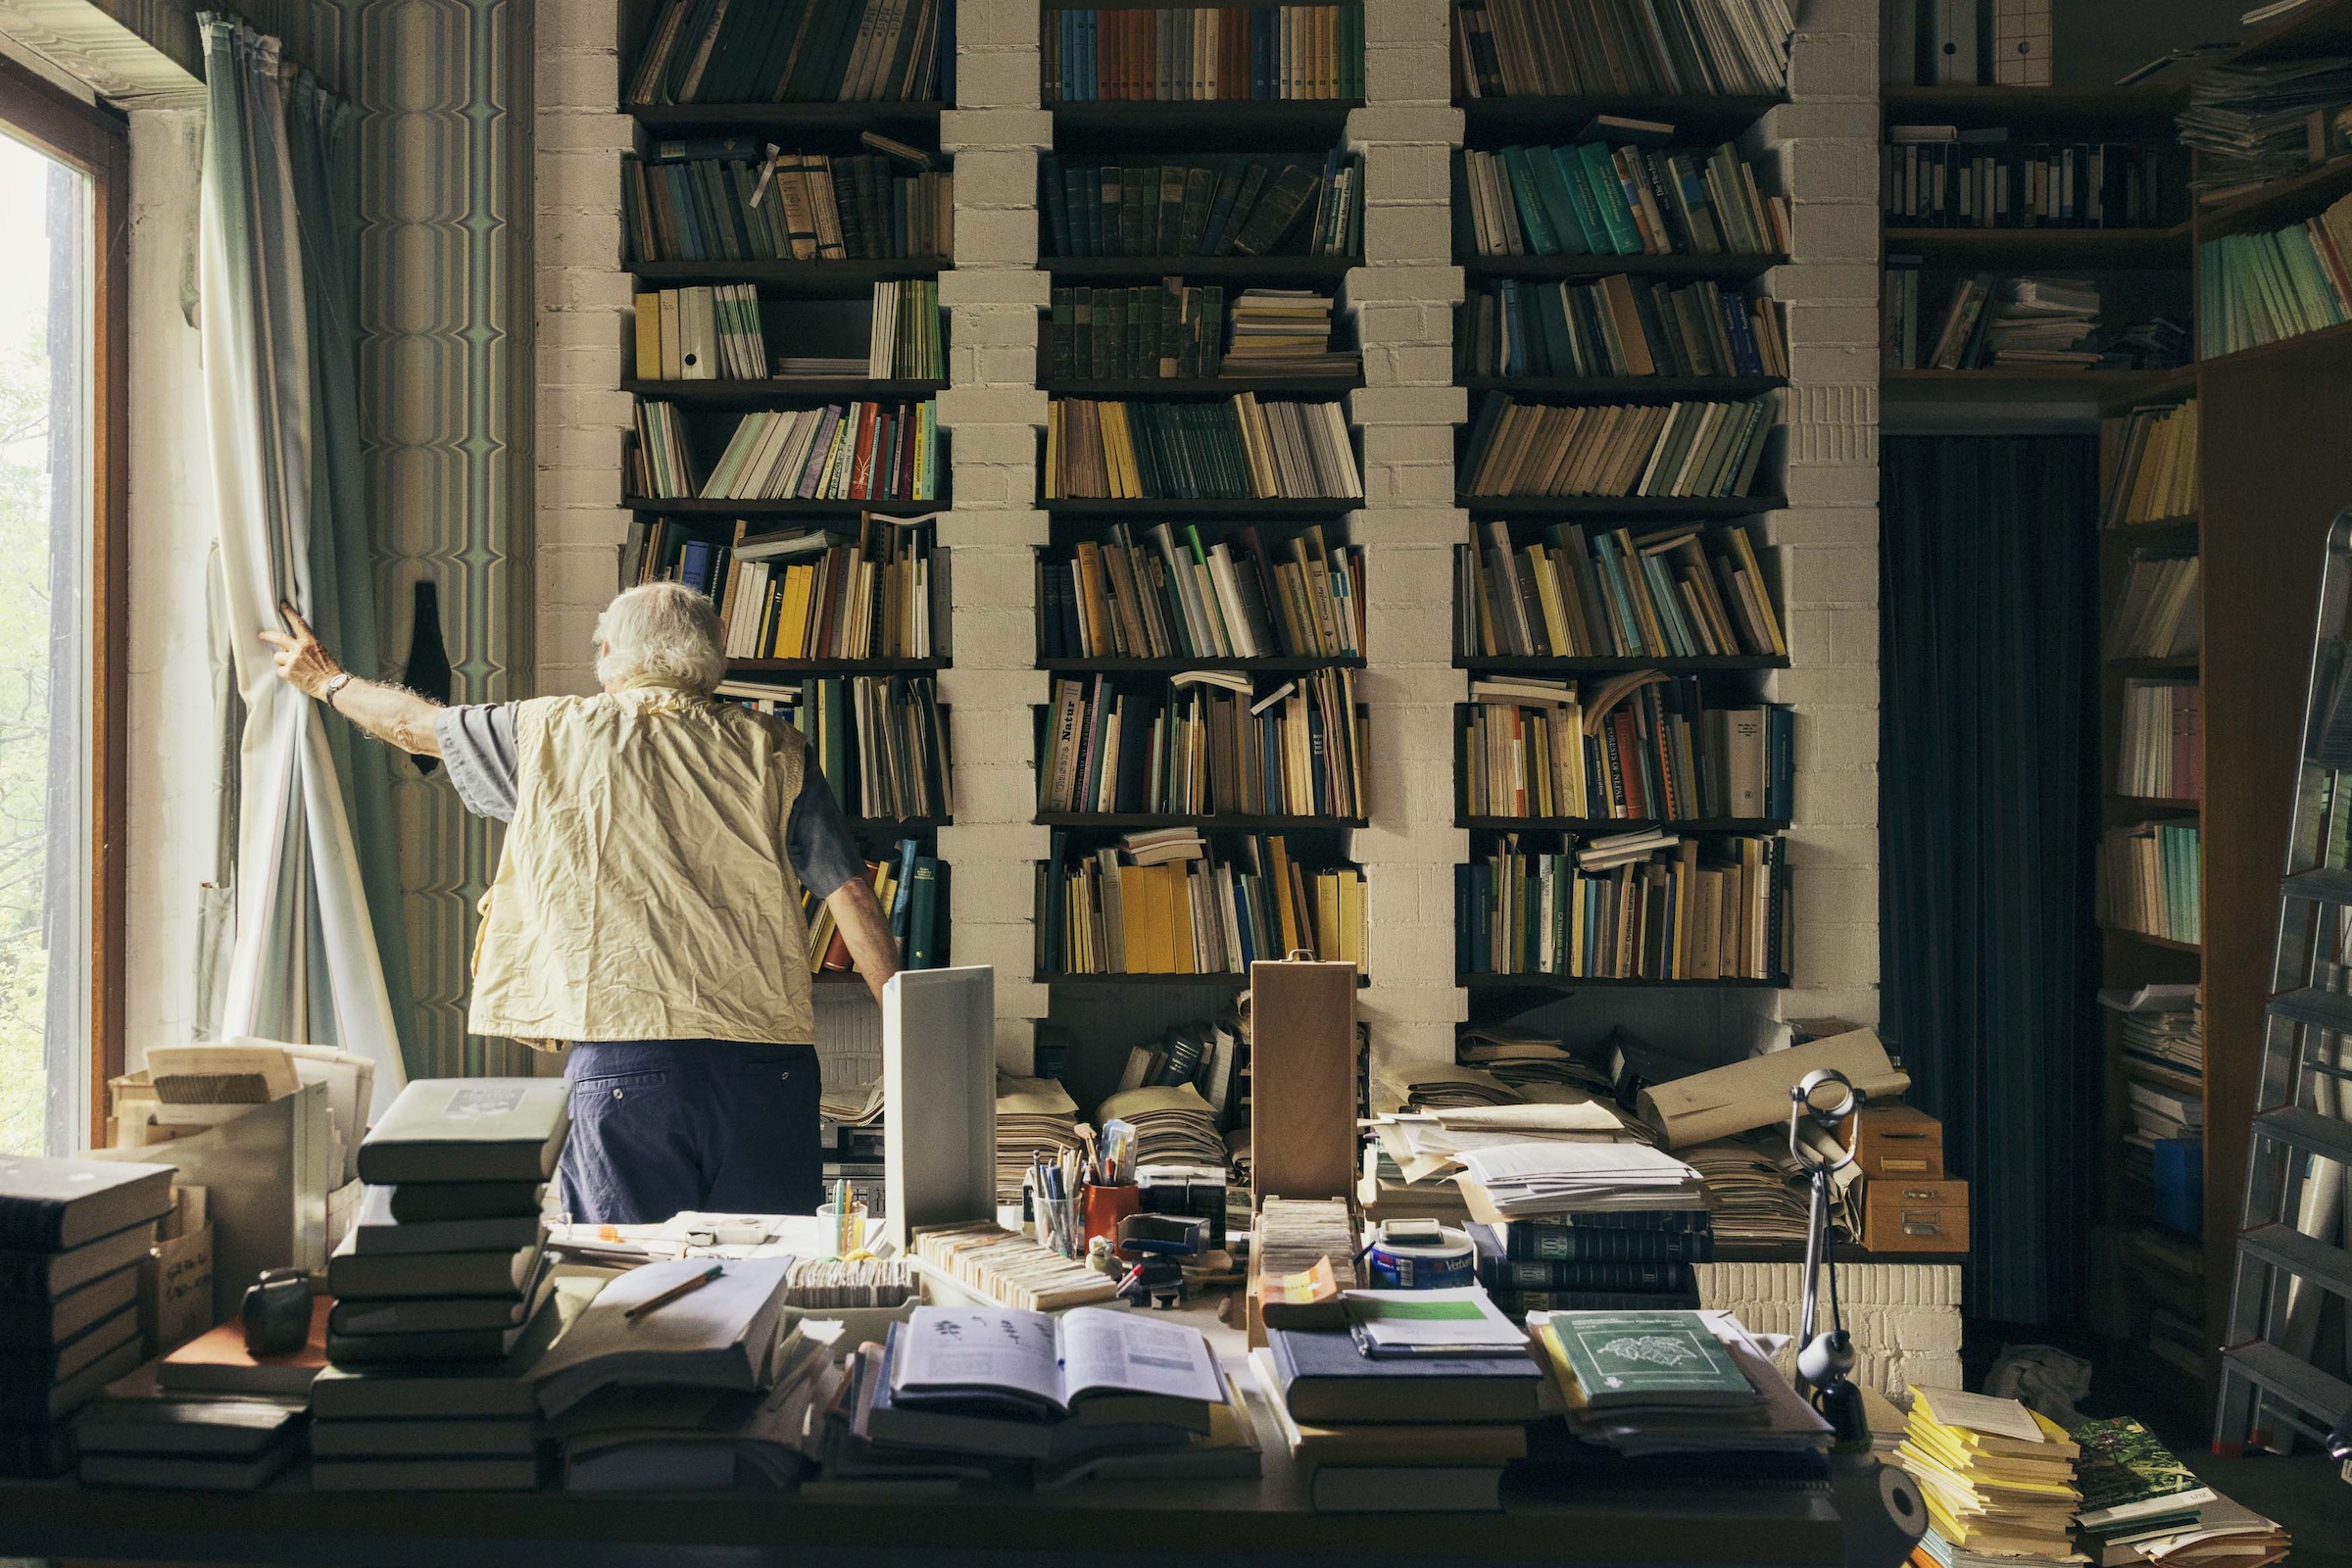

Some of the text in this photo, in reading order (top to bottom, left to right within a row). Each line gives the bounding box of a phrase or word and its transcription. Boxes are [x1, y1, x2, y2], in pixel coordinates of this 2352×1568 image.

[1061, 701, 1075, 742] Natur
[1607, 726, 1618, 760] FORESTS
[1613, 773, 1623, 801] NEPAL
